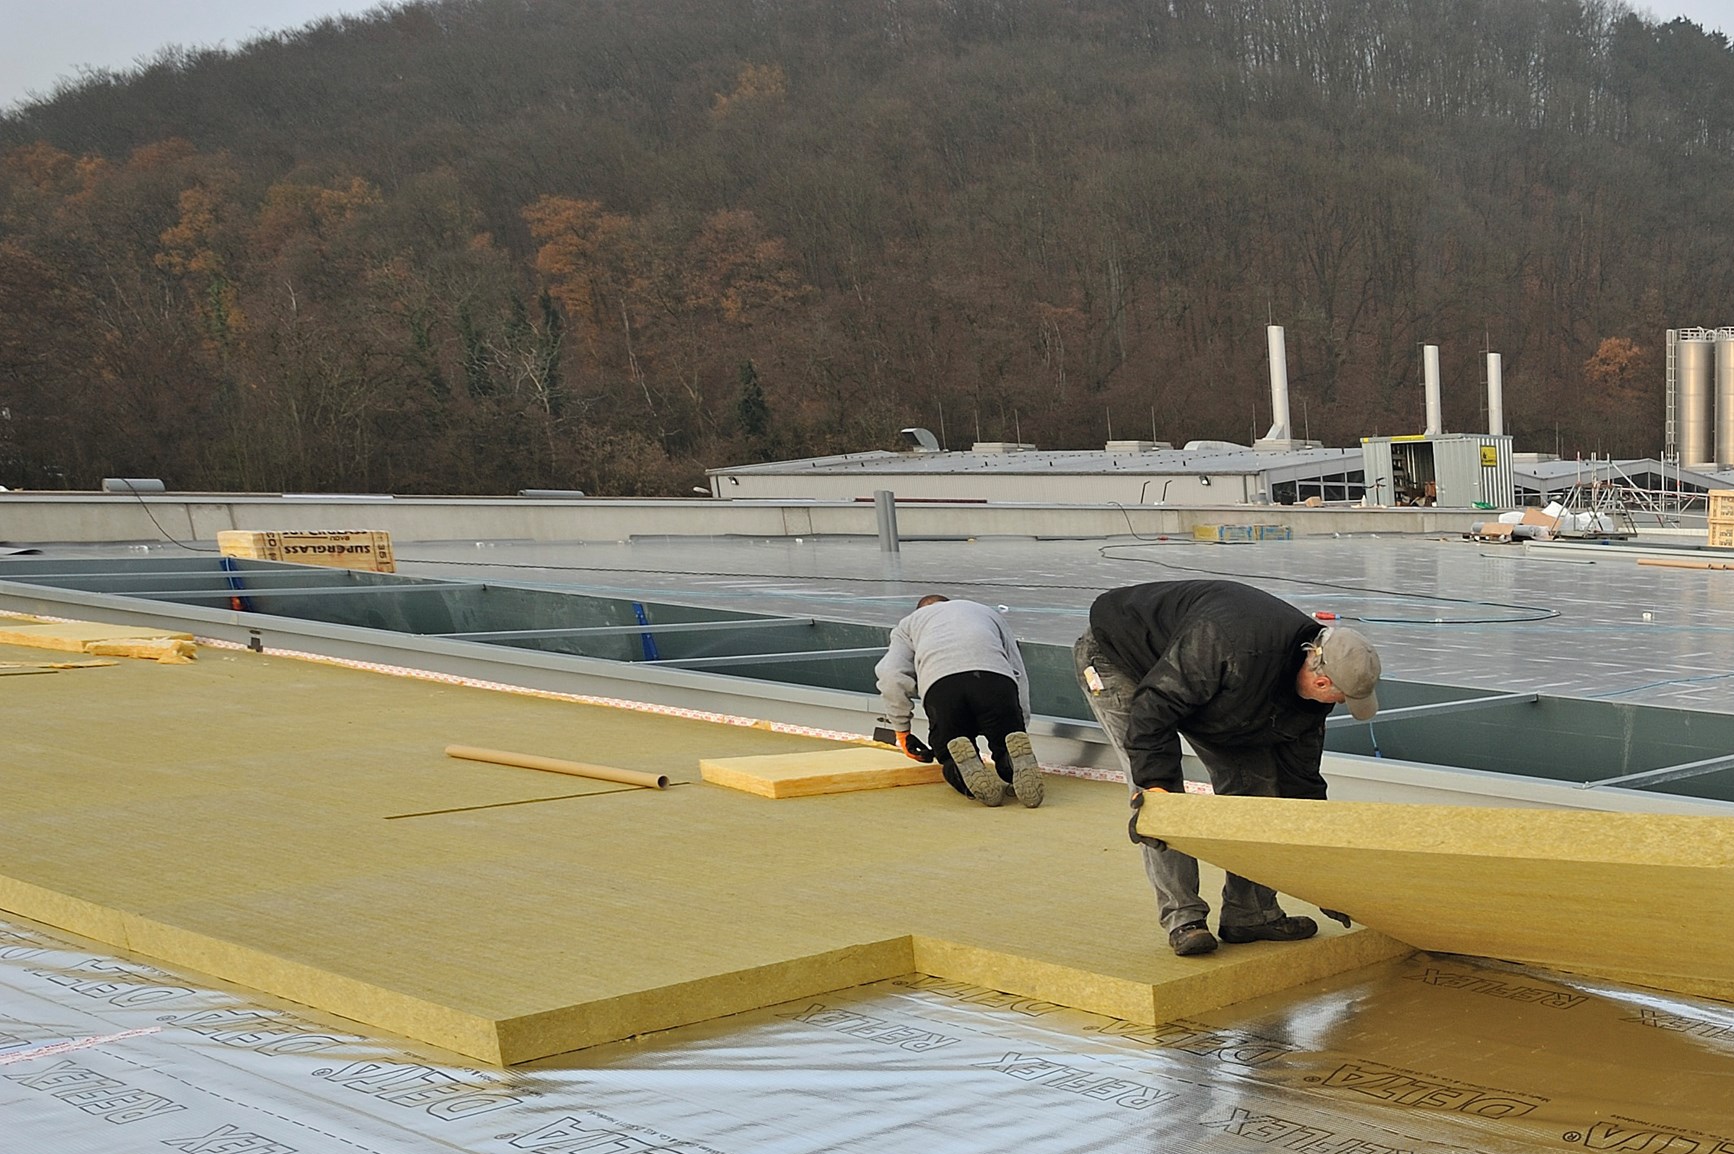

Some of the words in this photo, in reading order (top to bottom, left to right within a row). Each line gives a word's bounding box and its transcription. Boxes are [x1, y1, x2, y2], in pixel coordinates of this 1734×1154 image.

[284, 544, 371, 554] SUPERGLASS
[1403, 968, 1586, 1011] REFLEX
[776, 1003, 960, 1052] REFLEX
[2, 1059, 188, 1125] REFLEX
[971, 1051, 1180, 1110] REFLEX
